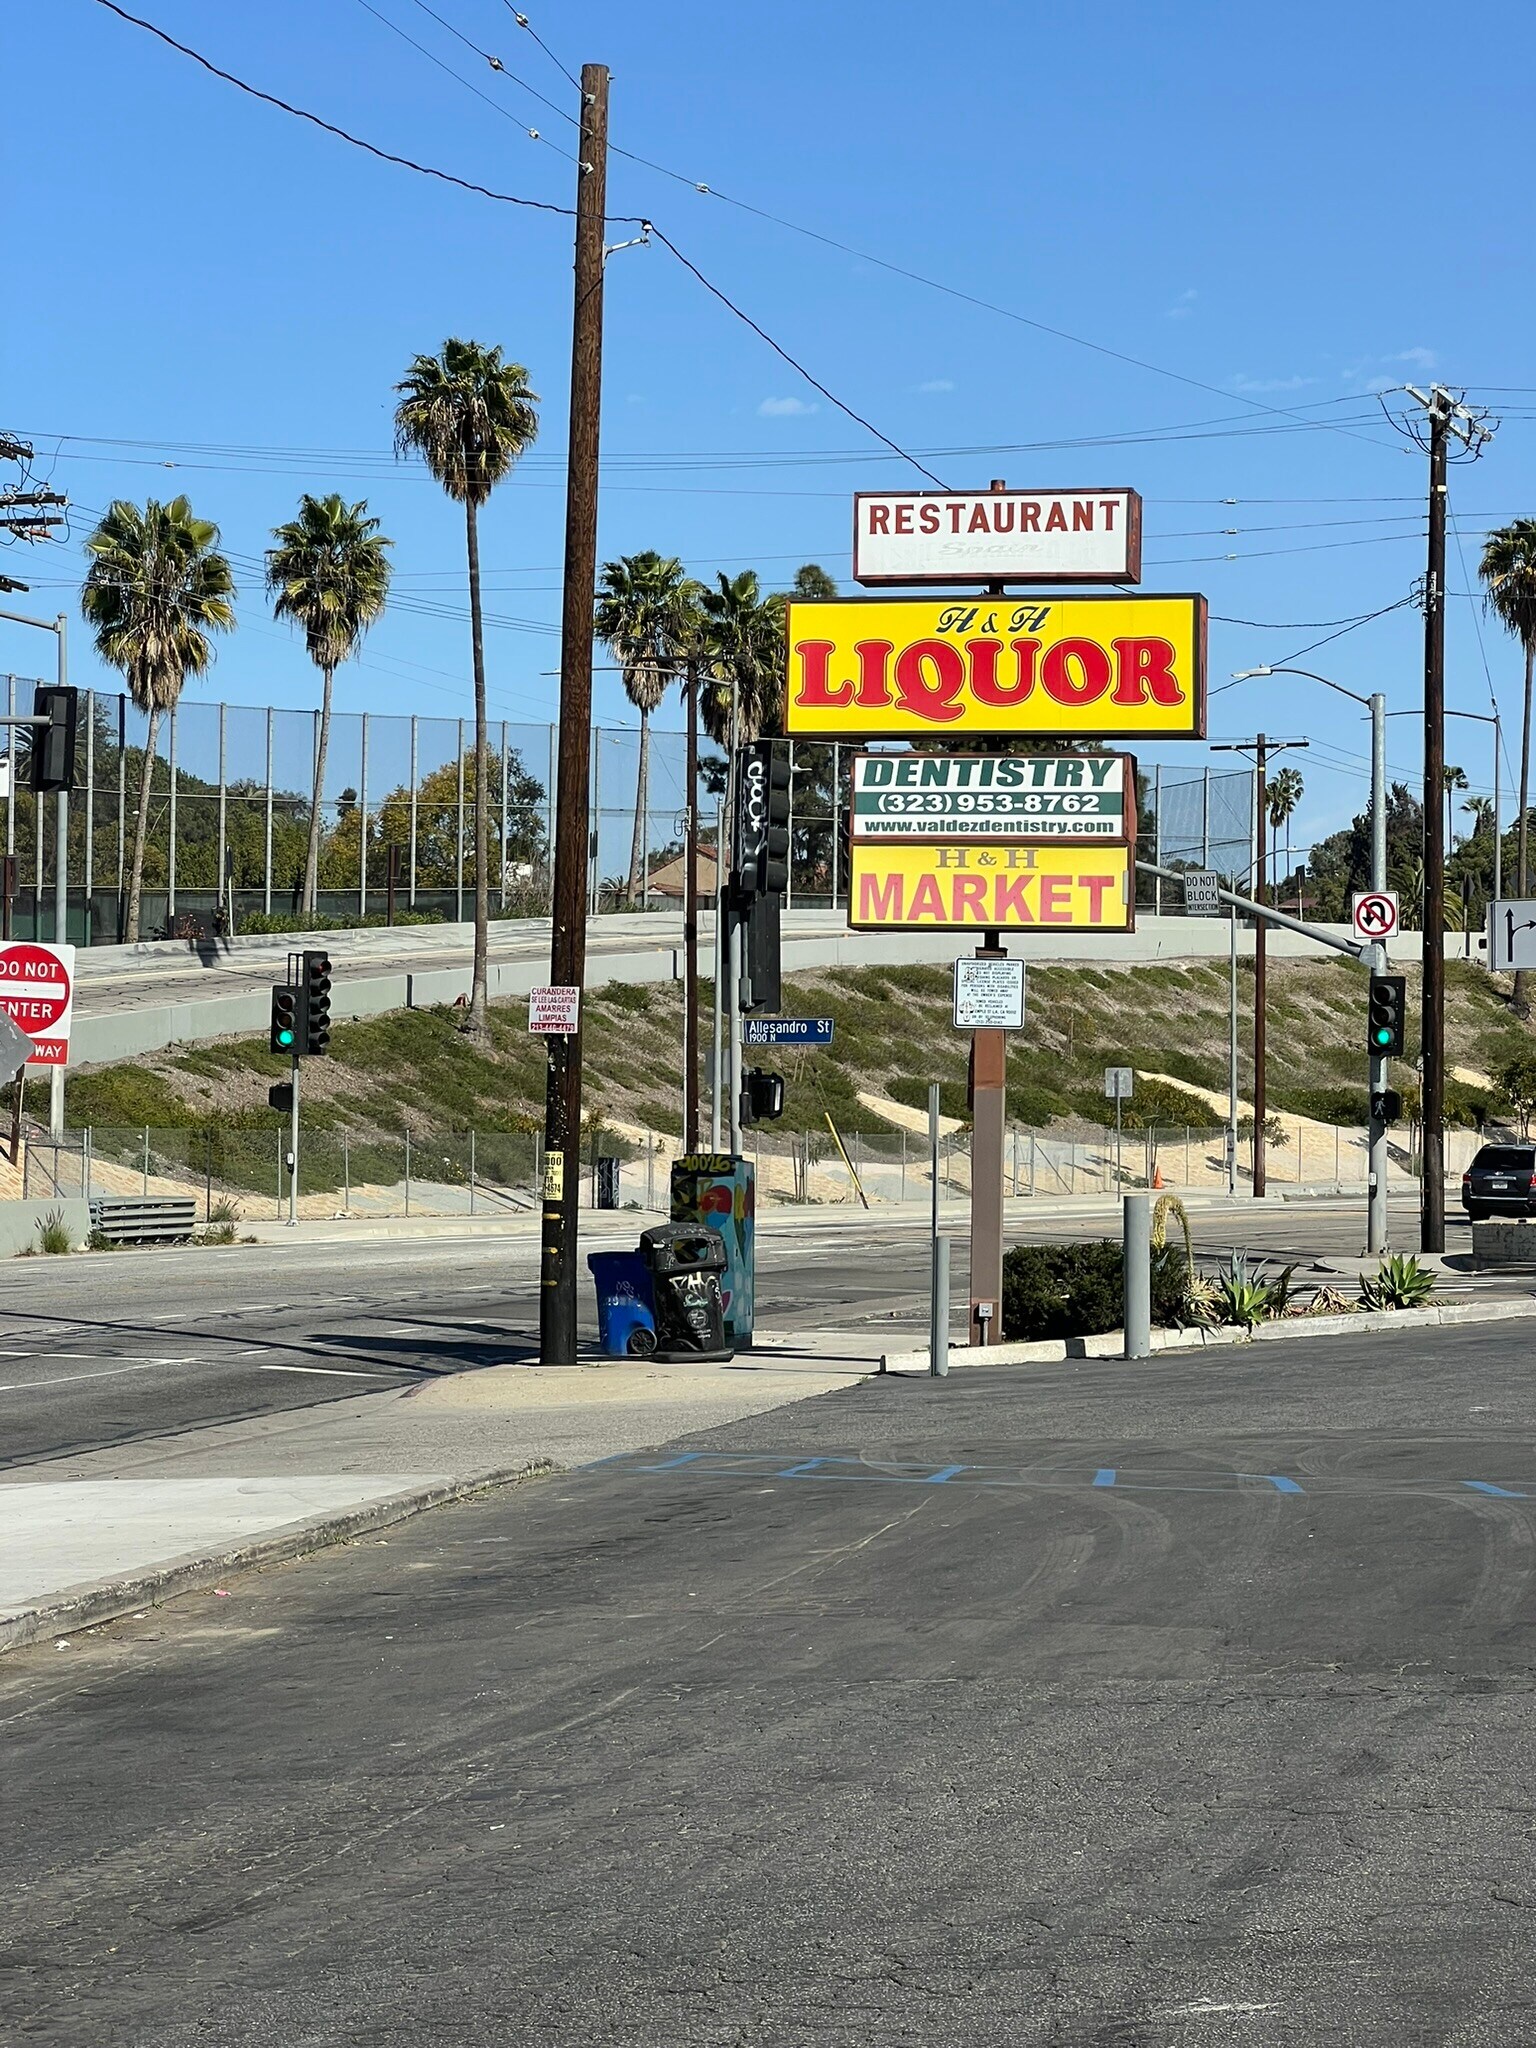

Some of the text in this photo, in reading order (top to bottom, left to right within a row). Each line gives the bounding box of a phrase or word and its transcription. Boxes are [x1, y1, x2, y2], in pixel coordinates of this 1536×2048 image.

[869, 500, 1120, 535] RESTAURANT
[935, 605, 1052, 634] H & H
[794, 636, 1186, 723] LIQUOR
[862, 758, 1116, 787] DENTISTRY
[864, 819, 1114, 834] www.valdezdentistry.com
[935, 848, 1040, 869] H & H
[1186, 876, 1216, 887] DO NOT
[858, 873, 1115, 923] MARKET
[1187, 890, 1217, 901] BLOCK
[24, 961, 59, 979] NOT
[531, 987, 576, 995] CURANDERA
[558, 996, 576, 1004] CARTAS
[0, 1000, 53, 1019] NTER
[536, 1005, 571, 1013] AMARRES
[538, 1014, 567, 1022] LIMPIAS
[748, 1020, 830, 1034] Allesandro St
[749, 1033, 776, 1042] 1900 N
[34, 1044, 63, 1058] WAY
